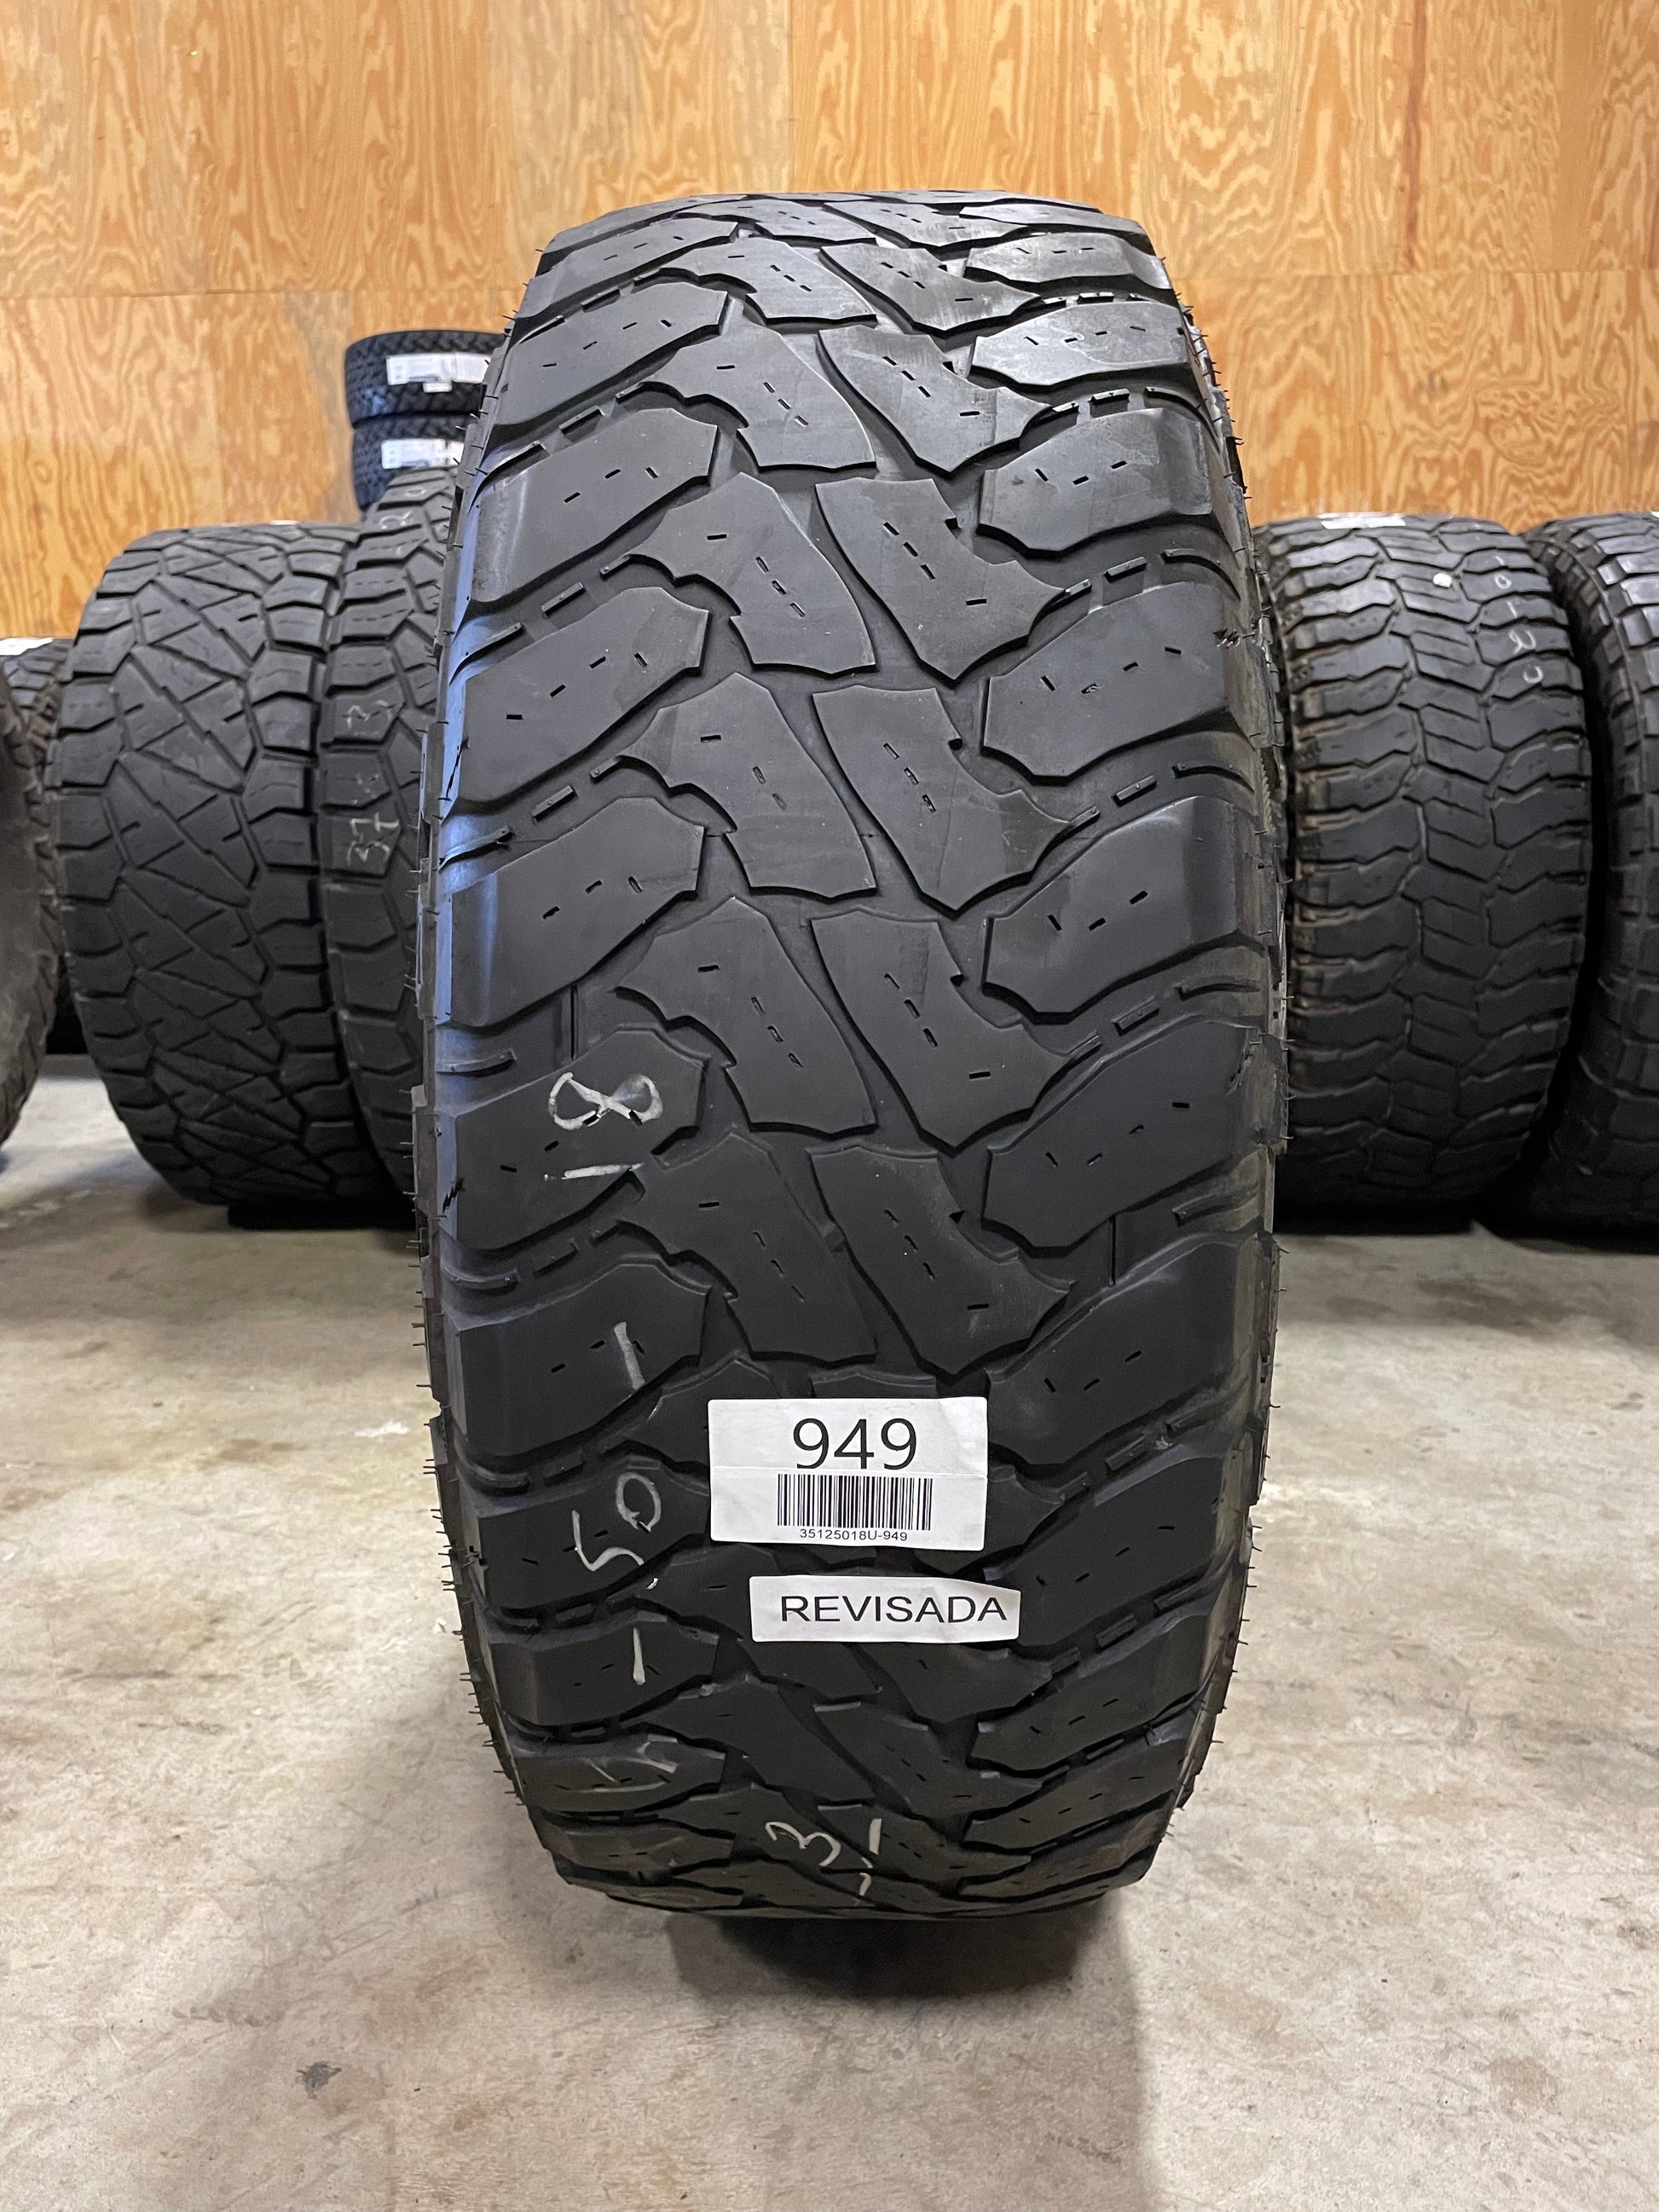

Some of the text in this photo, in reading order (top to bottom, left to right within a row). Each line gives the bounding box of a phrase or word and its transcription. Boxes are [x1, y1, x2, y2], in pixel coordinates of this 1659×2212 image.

[793, 1418, 917, 1470] 949
[799, 1528, 908, 1542] 35125018U-949
[780, 1595, 1008, 1624] REVISADA
